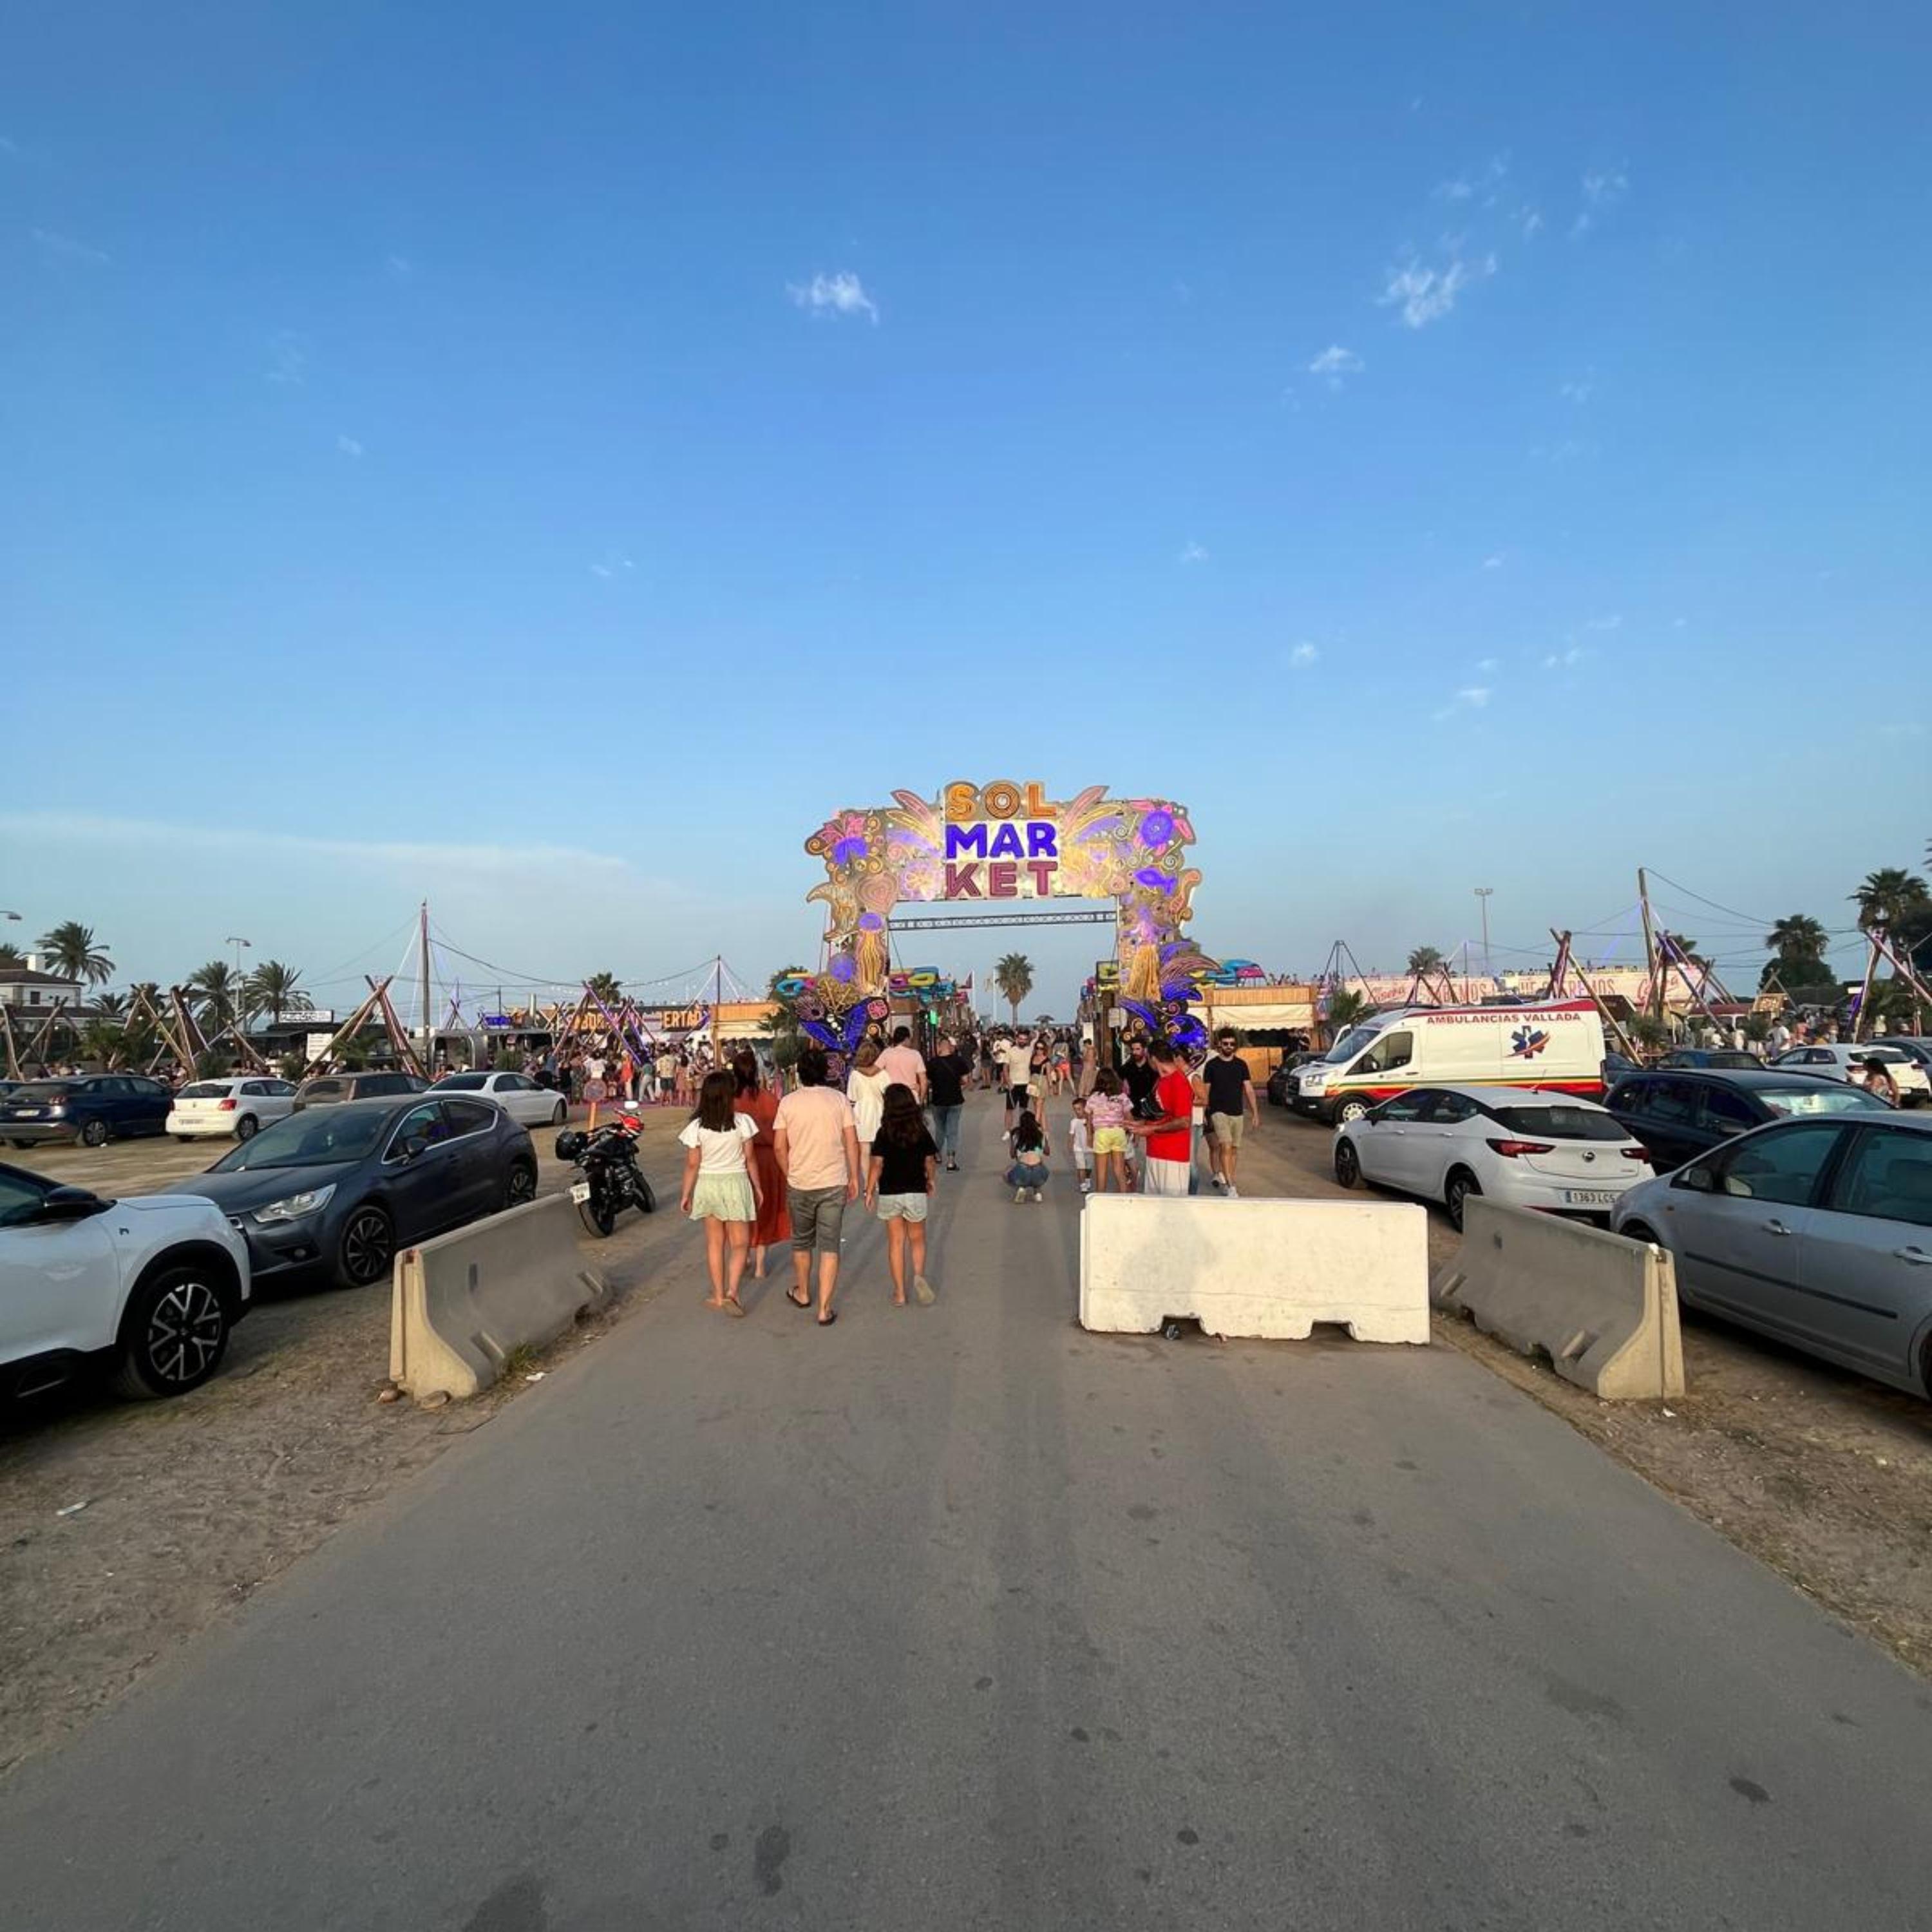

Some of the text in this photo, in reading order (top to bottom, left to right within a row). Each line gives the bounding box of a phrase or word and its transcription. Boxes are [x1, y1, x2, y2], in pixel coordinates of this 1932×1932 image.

[945, 783, 1057, 821] SOL
[945, 822, 1058, 860] MAR
[945, 861, 1059, 898] KET
[1427, 1013, 1582, 1025] AMBULANCIAS VALLADA
